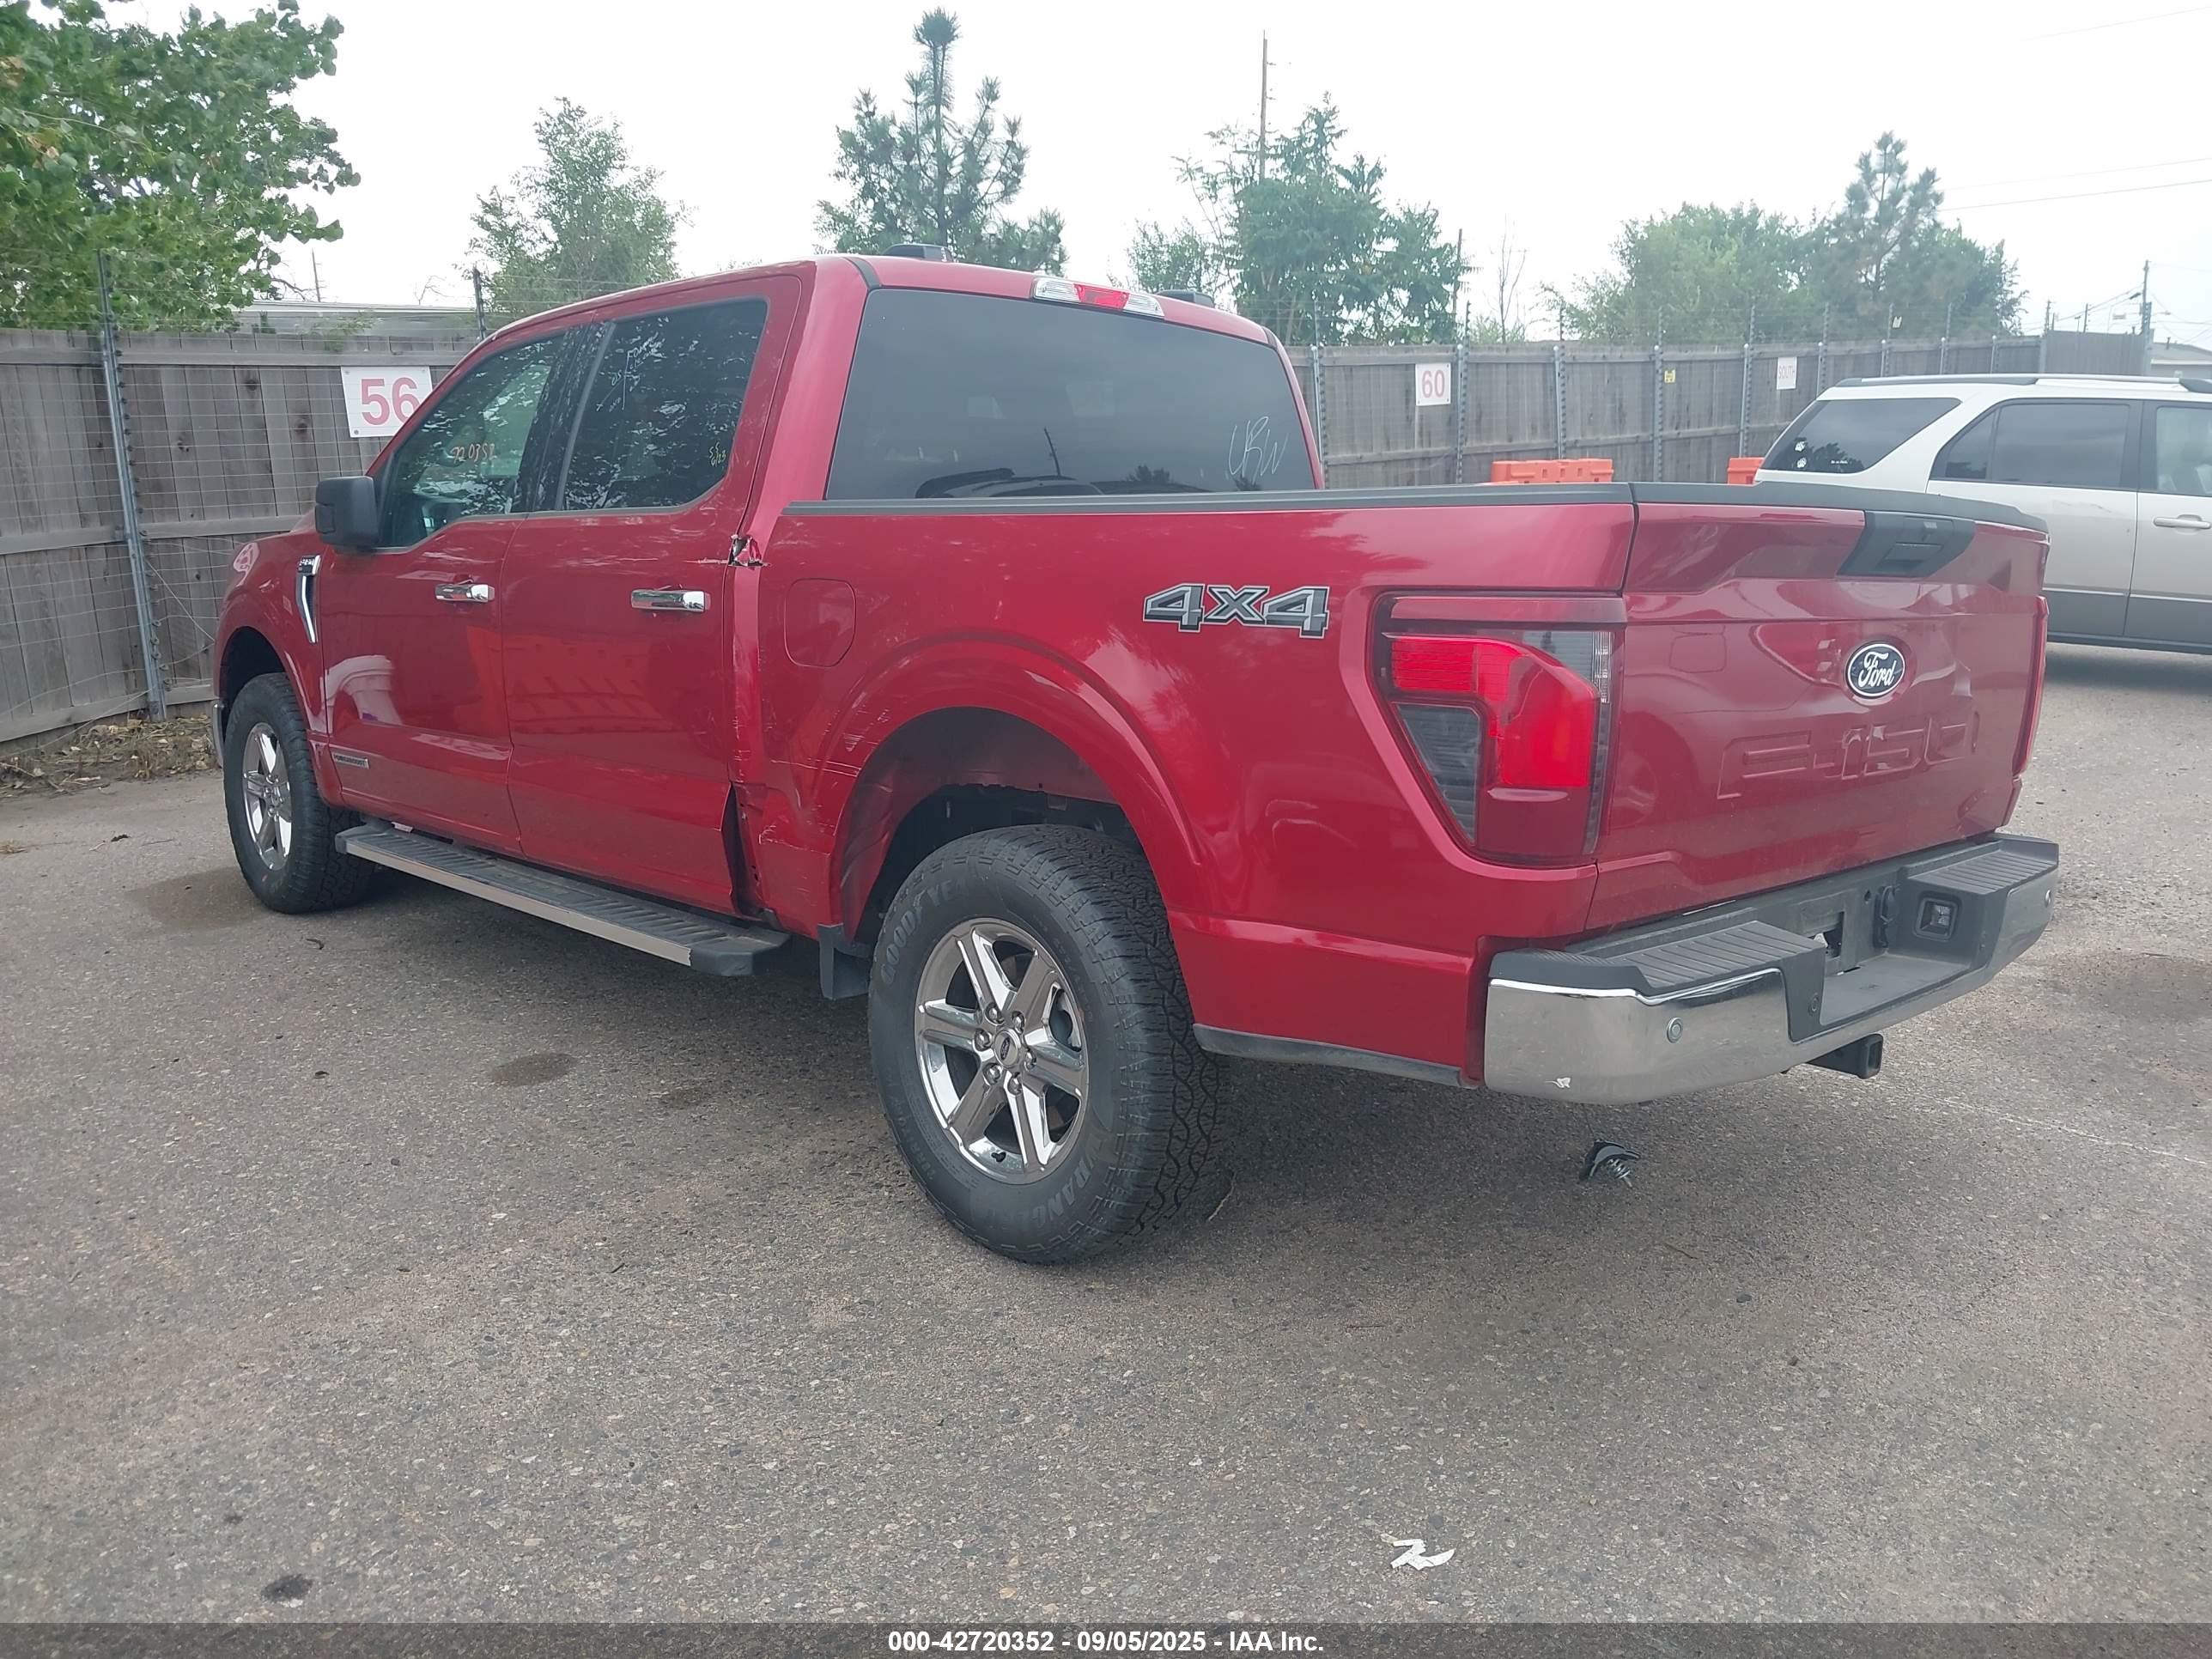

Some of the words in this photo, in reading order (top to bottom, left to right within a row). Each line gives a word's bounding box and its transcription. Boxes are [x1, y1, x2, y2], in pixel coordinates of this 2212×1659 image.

[362, 377, 420, 425] 56
[1422, 370, 1444, 398] 60
[1858, 651, 1897, 688] Ford
[1717, 713, 1980, 799] F-150
[880, 876, 977, 985] GOODYEA
[1022, 1133, 1106, 1229] WRANG
